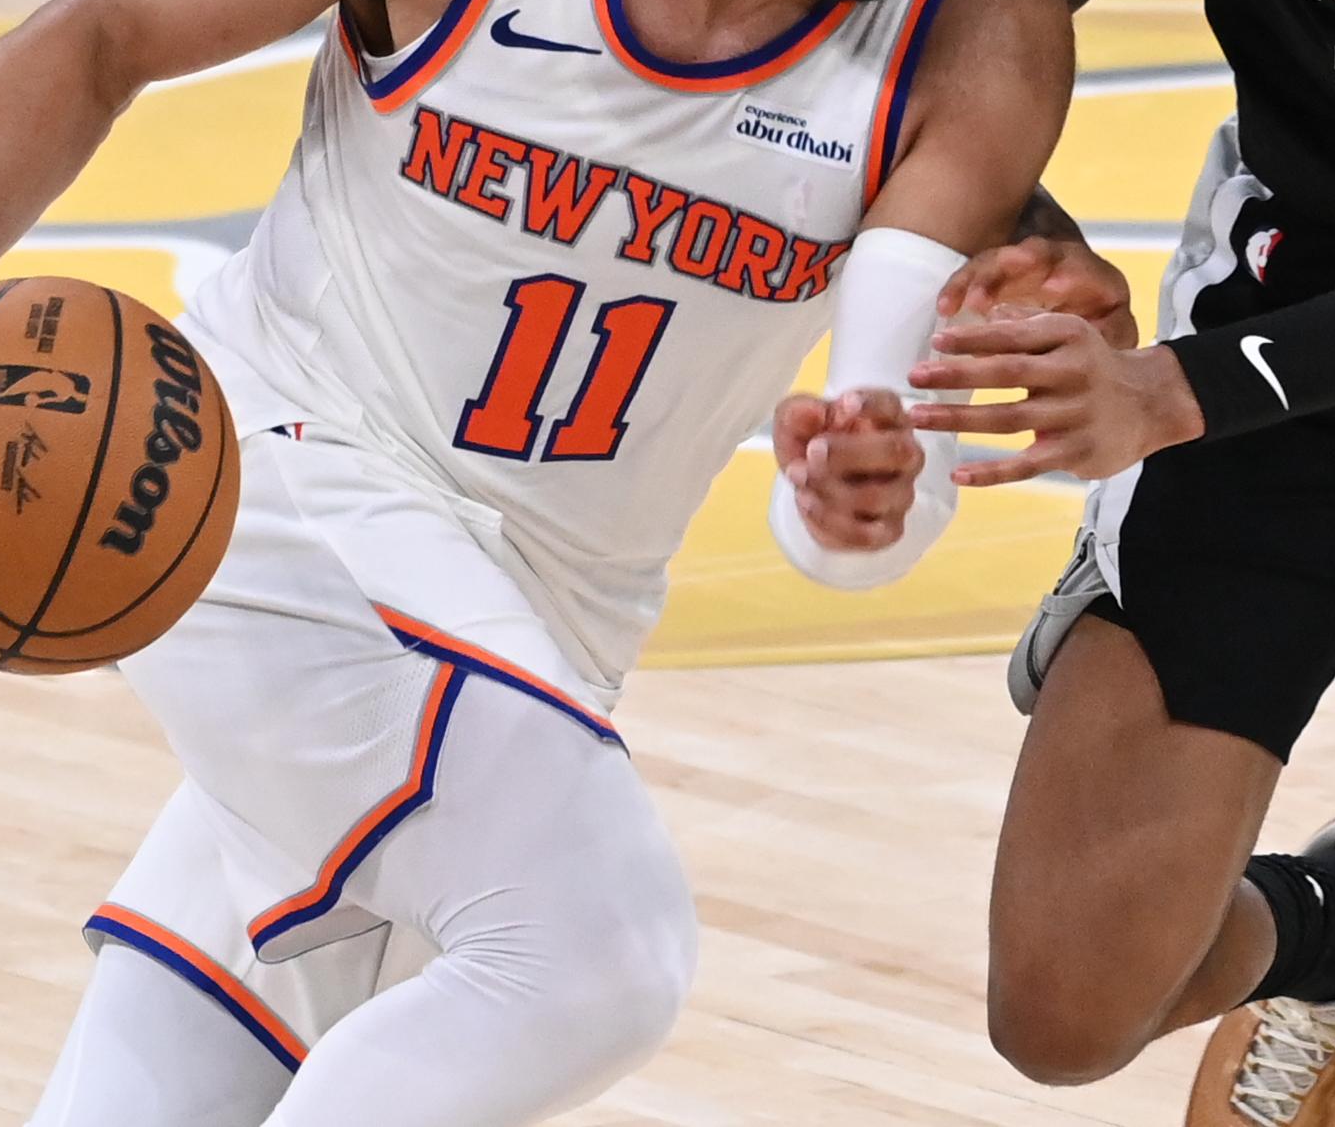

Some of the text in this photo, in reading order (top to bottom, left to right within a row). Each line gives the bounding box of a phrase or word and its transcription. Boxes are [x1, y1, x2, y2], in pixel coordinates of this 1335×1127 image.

[400, 103, 852, 303] NEW YORK
[736, 119, 854, 163] abu dhabi
[744, 105, 807, 128] experience
[98, 323, 203, 556] Wilson
[452, 273, 678, 462] 11
